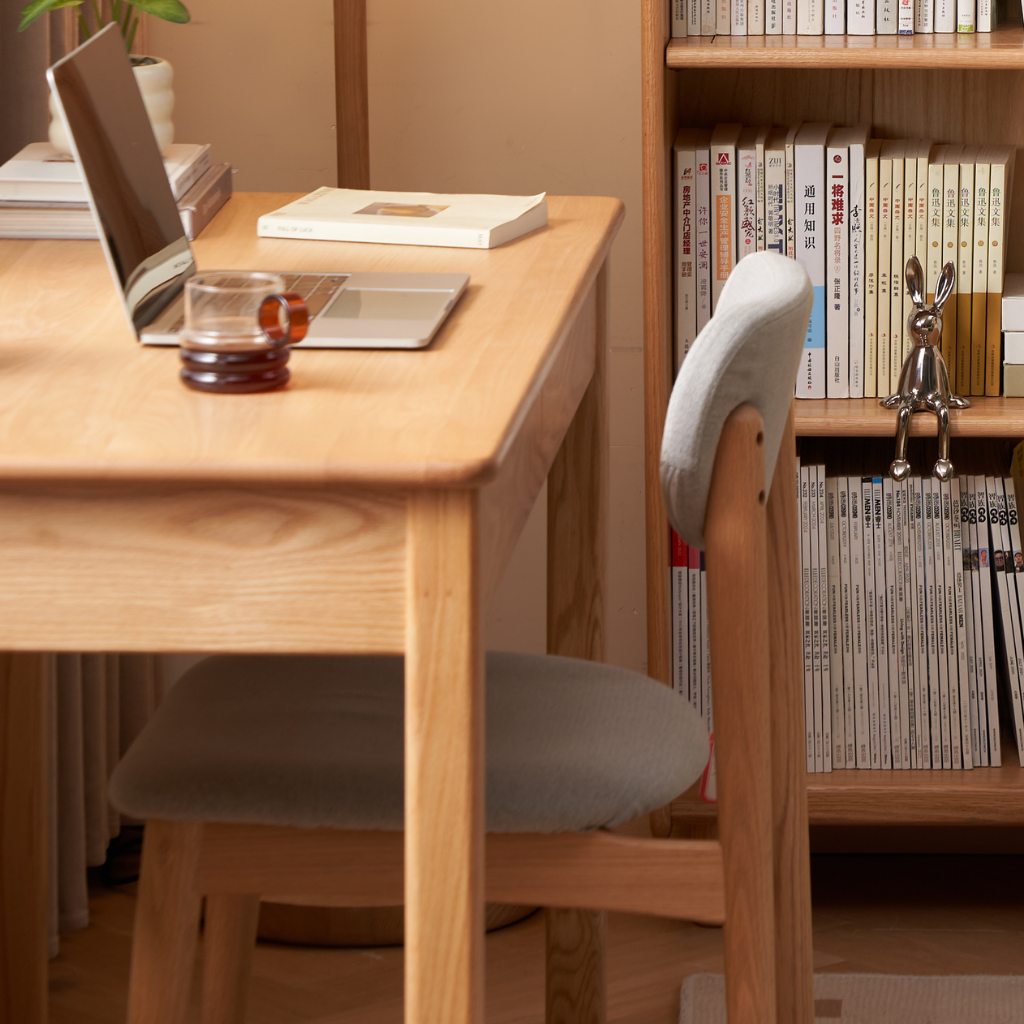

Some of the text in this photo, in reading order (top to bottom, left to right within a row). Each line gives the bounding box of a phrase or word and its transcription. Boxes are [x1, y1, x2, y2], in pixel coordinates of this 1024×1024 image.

[804, 184, 816, 250] 通用知识
[832, 175, 845, 226] 一将难求
[931, 187, 941, 227] 鲁迅文集
[946, 188, 955, 228] 鲁迅文集
[960, 187, 970, 227] 鲁迅文集
[977, 187, 987, 226] 鲁迅文集
[992, 187, 1001, 227] 鲁迅文集
[961, 507, 969, 523] GQ
[968, 509, 977, 524] GQ
[978, 507, 986, 523] GQ
[990, 508, 999, 524] GQ
[998, 510, 1007, 526] GQ
[1009, 509, 1018, 525] GQ
